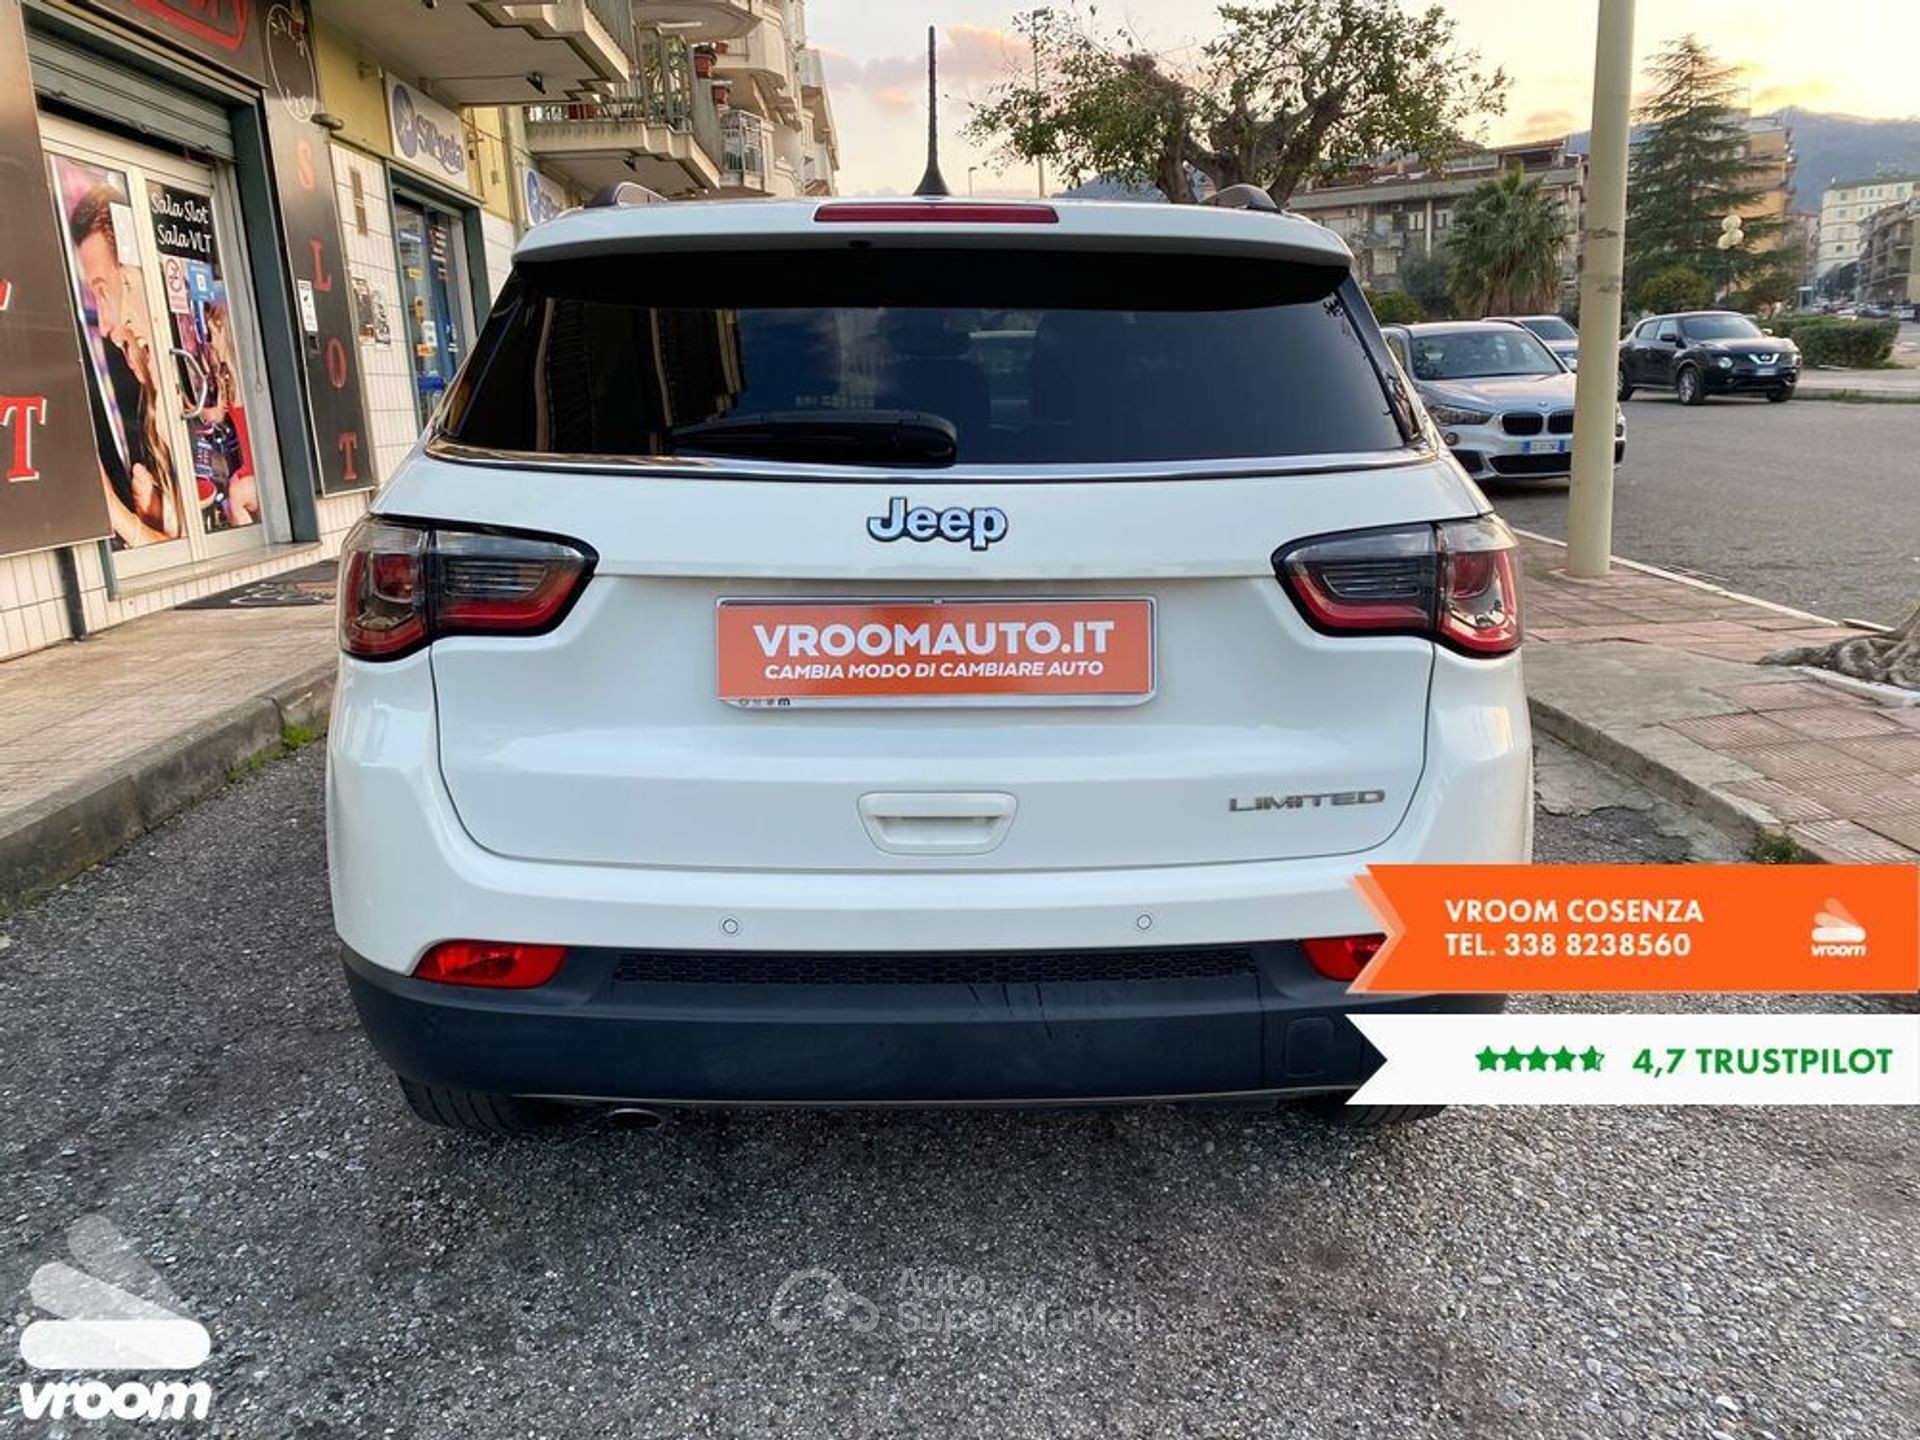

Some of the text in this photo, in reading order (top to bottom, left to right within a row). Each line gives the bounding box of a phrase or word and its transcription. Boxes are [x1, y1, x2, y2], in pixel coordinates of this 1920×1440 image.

[151, 191, 208, 224] Sala Slot
[157, 224, 212, 253] Sala VLT
[867, 497, 1009, 551] Jeep
[753, 620, 1115, 657] VROOMAUTO.IT
[765, 660, 1104, 680] CAMBIA MODO DI CAMBIARE AUTO
[1229, 789, 1386, 812] LIMITED
